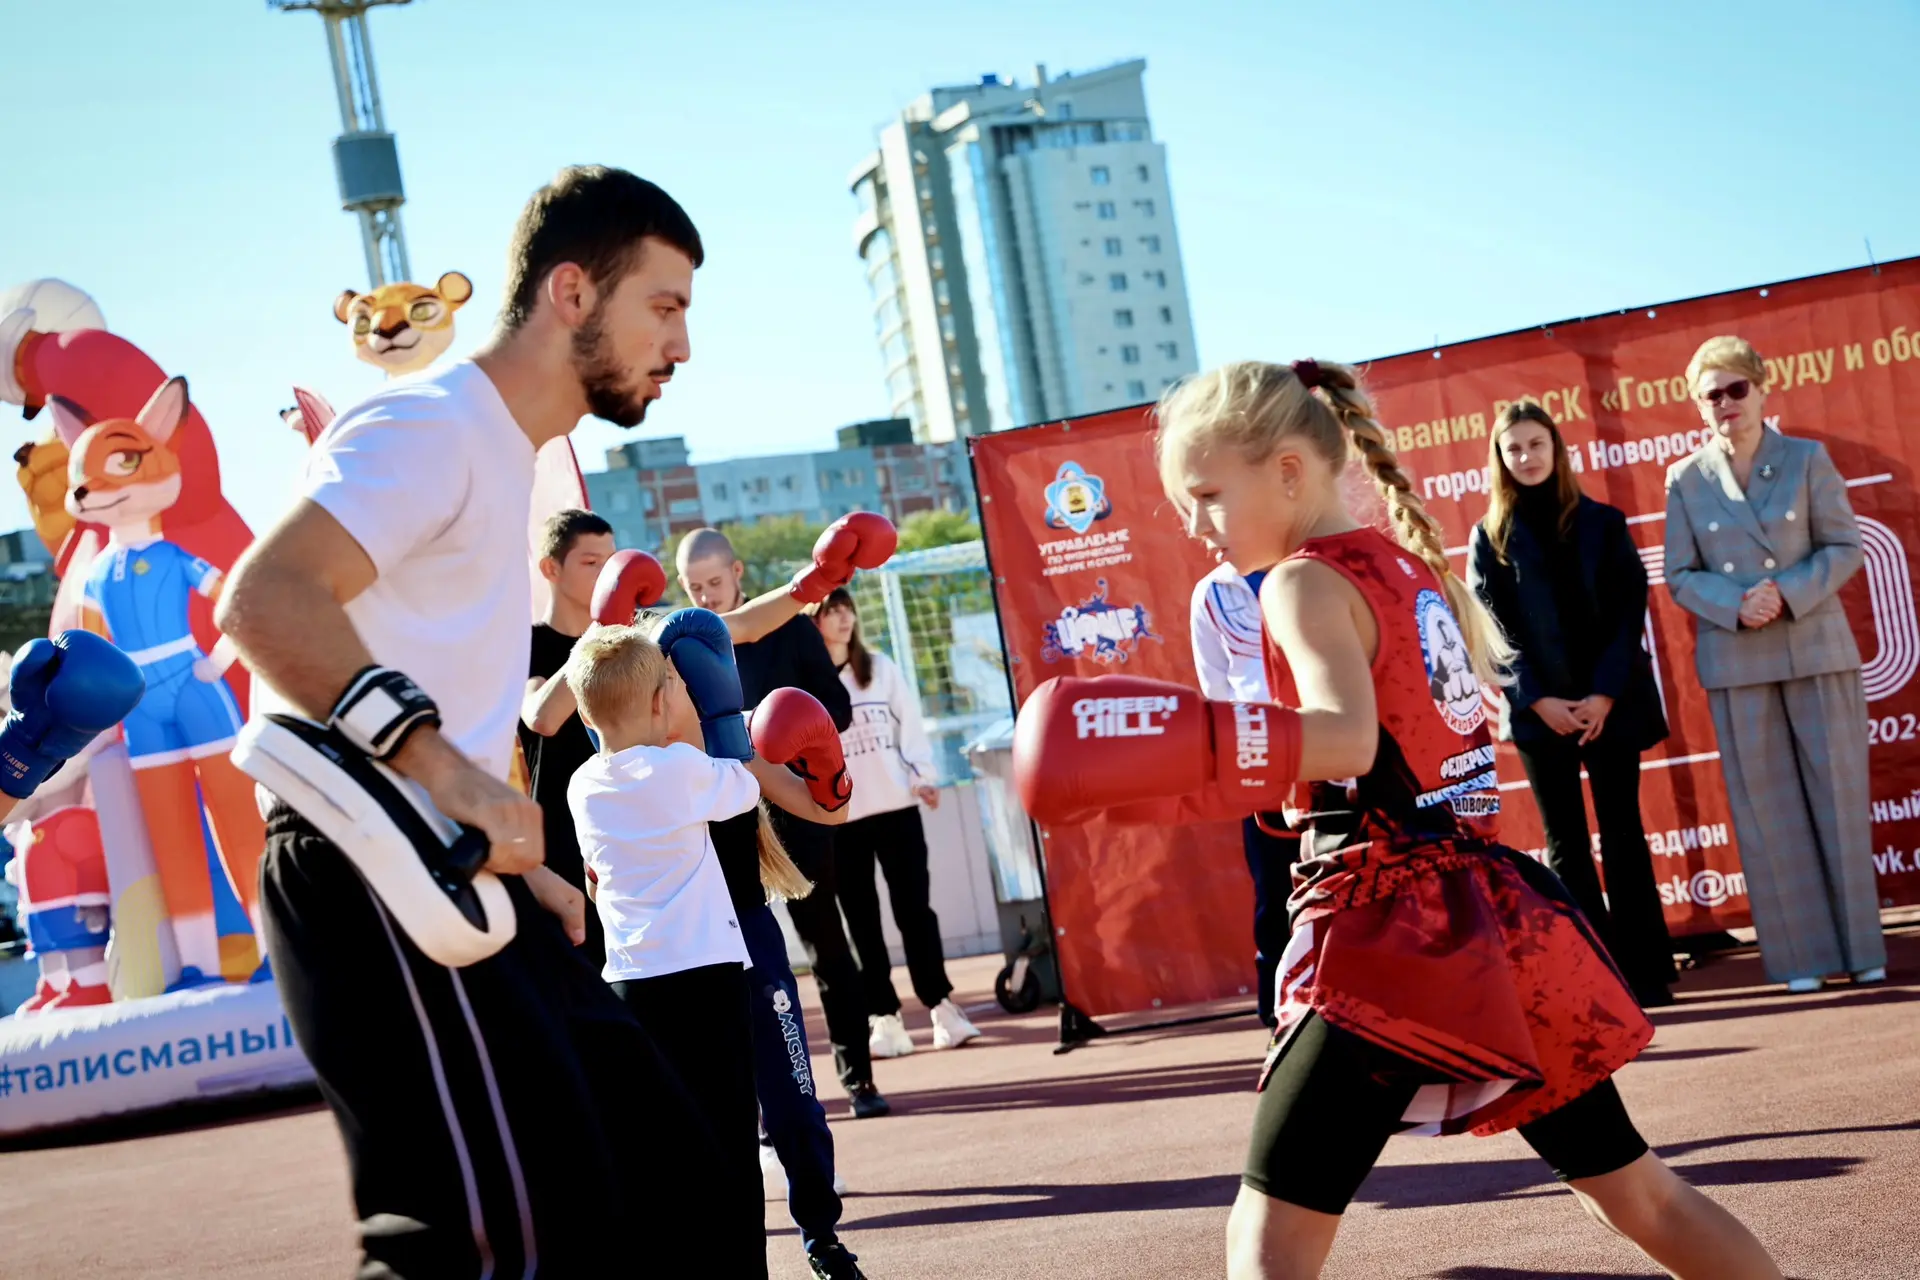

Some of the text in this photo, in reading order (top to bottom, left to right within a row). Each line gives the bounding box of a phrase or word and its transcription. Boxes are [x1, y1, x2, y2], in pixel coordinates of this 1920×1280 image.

[1601, 376, 1690, 412] «Гото
[1763, 347, 1834, 394] руду
[1844, 338, 1864, 371] и
[1072, 696, 1179, 717] GREEN
[1076, 711, 1165, 739] HILL
[1250, 707, 1268, 767] HILL
[1868, 713, 1920, 745] 202
[1644, 823, 1729, 858] адион
[1656, 870, 1748, 907] sk@m
[778, 1012, 813, 1096] MICKEY
